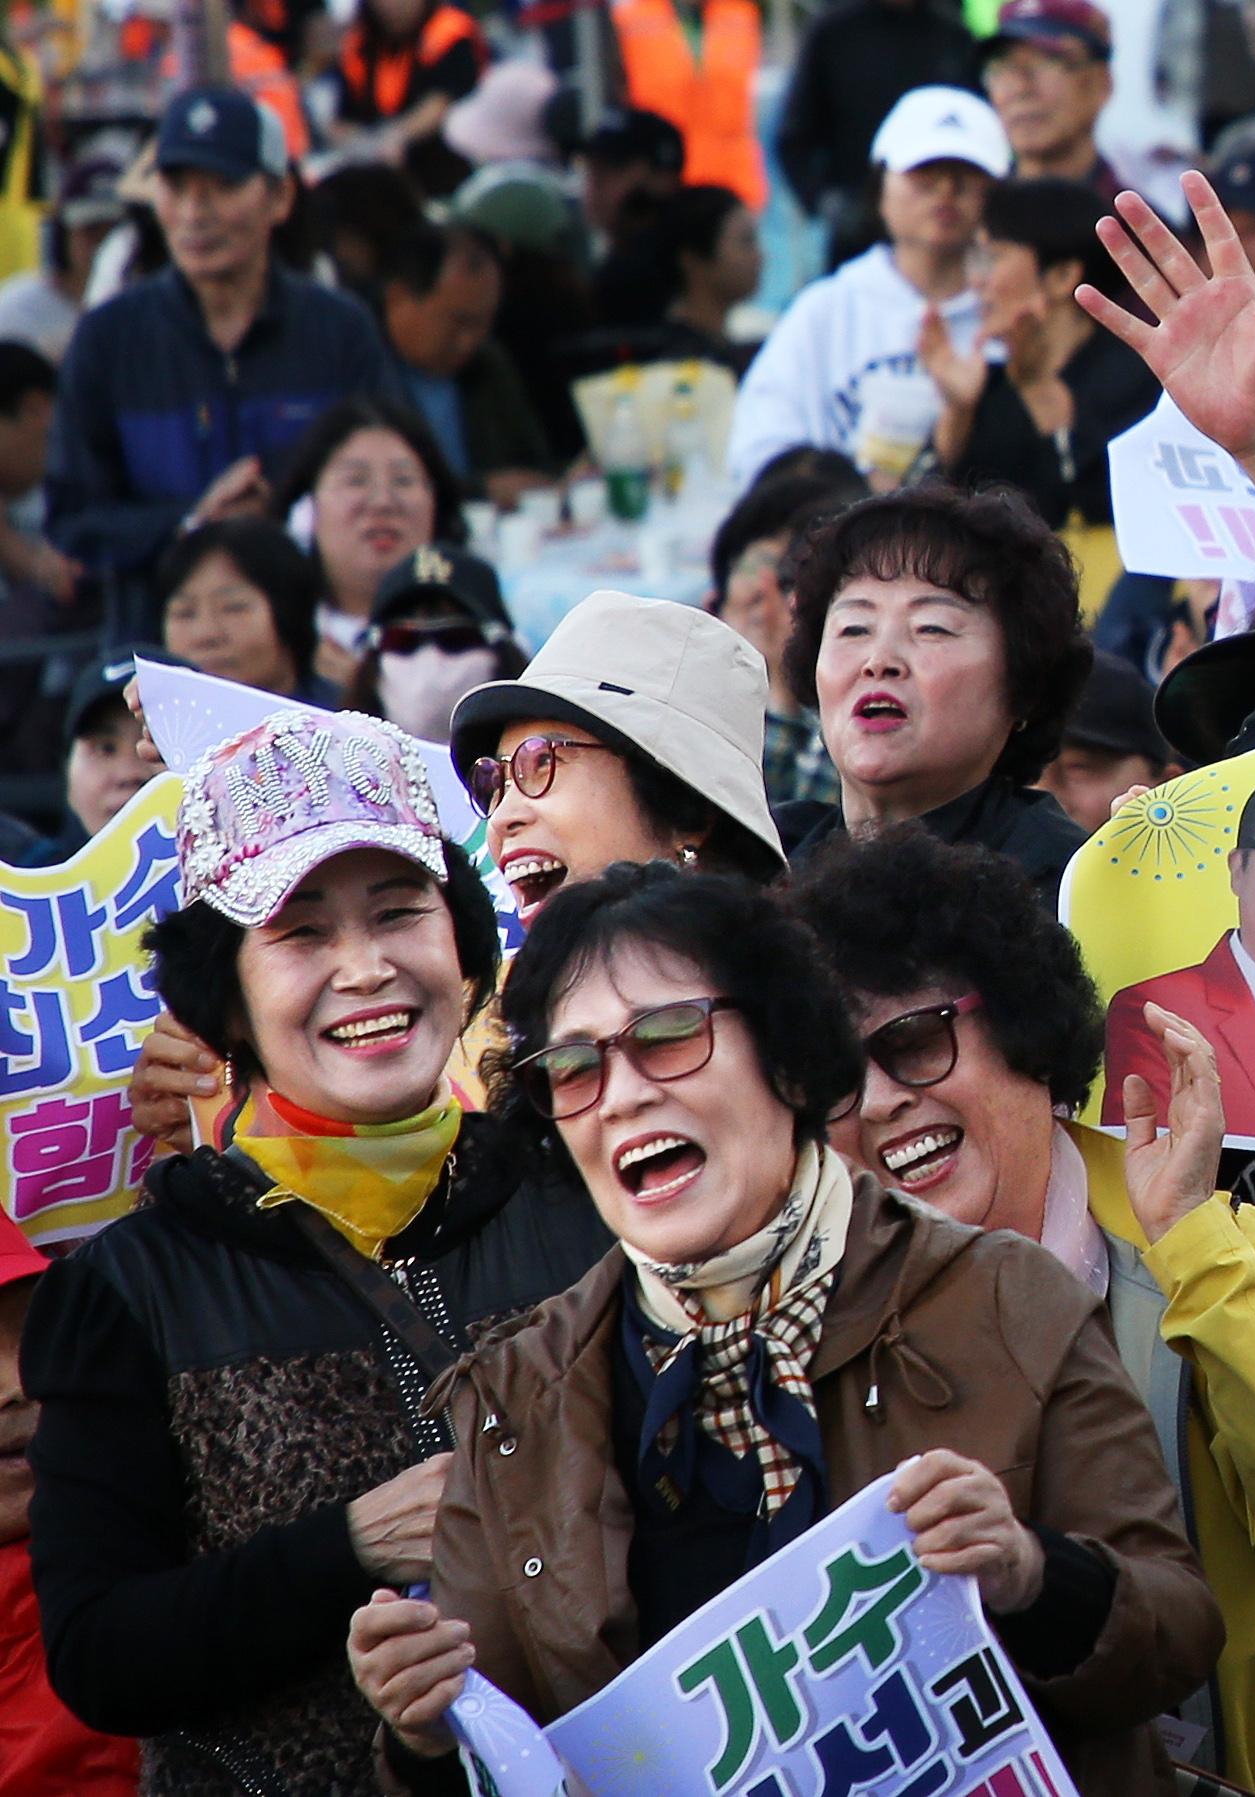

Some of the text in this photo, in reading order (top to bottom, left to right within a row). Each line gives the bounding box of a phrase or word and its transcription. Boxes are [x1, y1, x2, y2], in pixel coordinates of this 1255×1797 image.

[225, 728, 393, 839] NYC
[677, 1548, 923, 1790] 가수
[745, 1646, 1026, 1797] 선과
